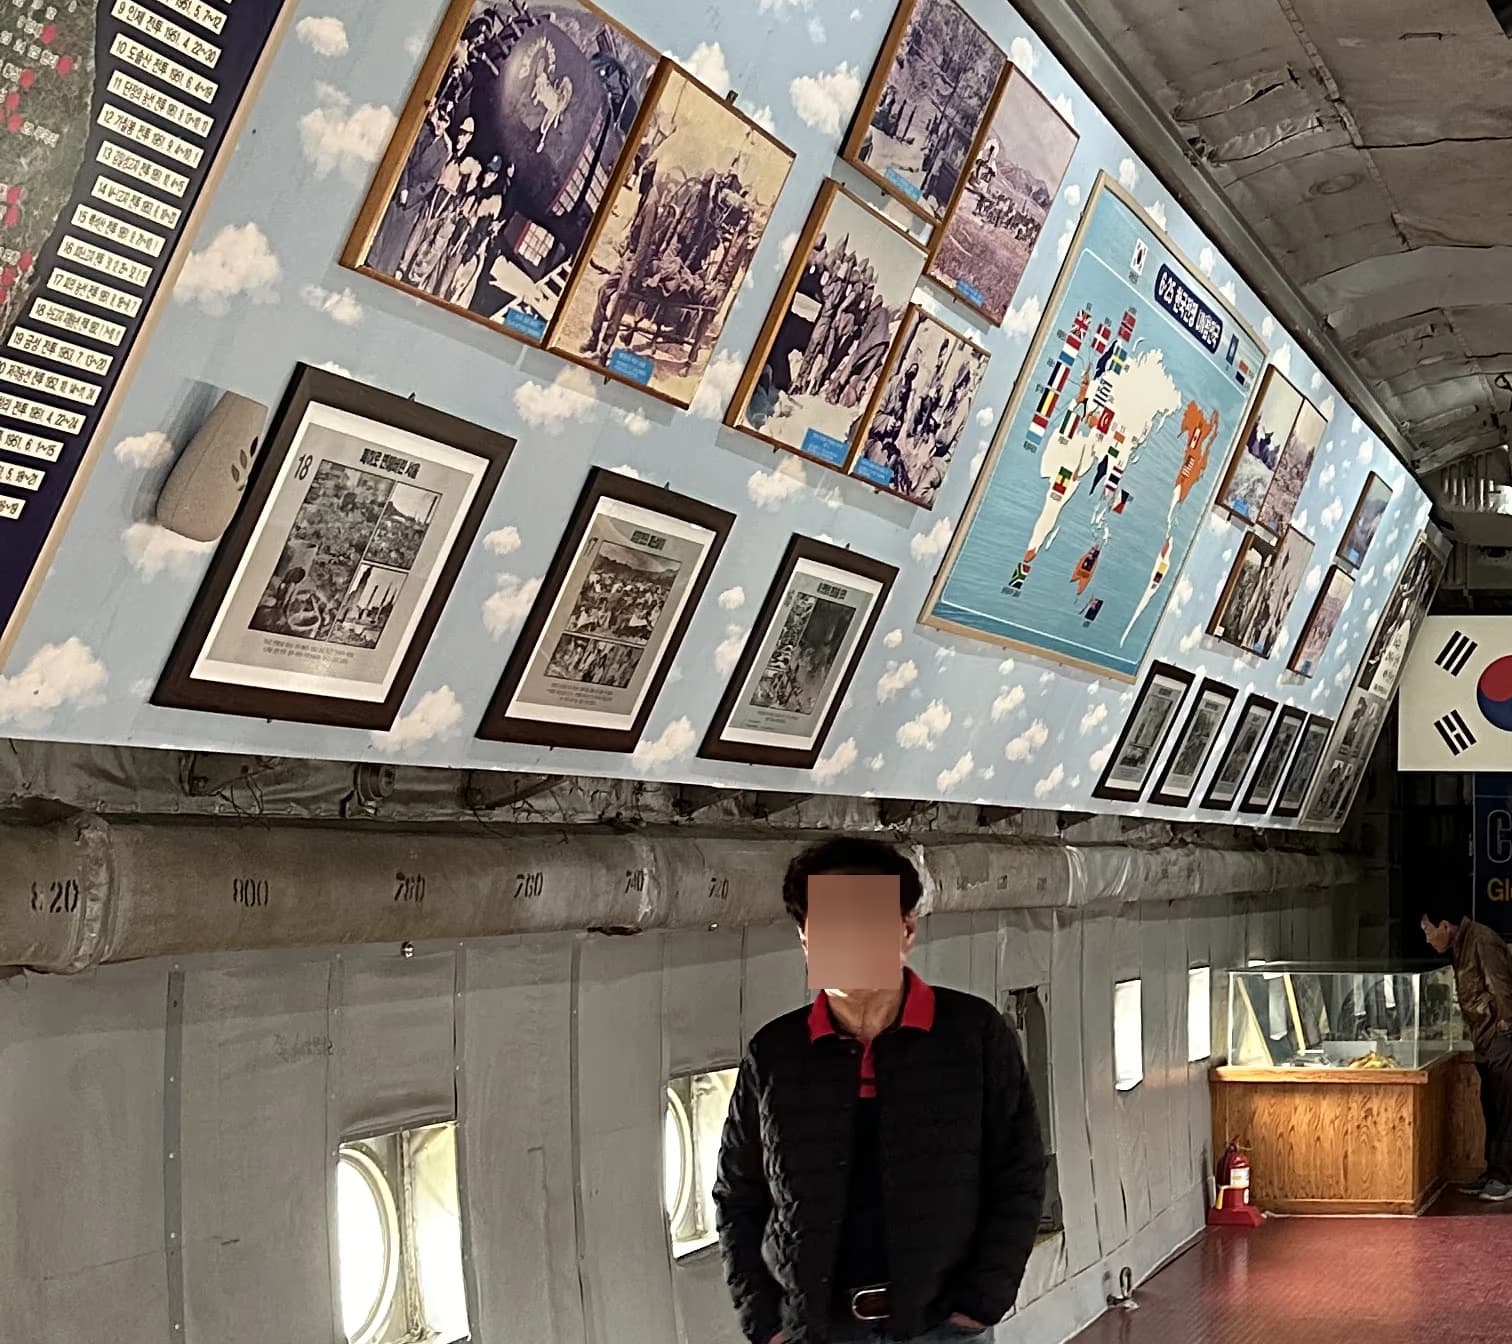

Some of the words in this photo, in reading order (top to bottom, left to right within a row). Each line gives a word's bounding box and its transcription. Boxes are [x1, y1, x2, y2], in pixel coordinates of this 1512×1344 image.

[116, 0, 127, 15] 9
[124, 2, 146, 26] 인제
[144, 13, 165, 36] 전투
[115, 38, 128, 56] 10
[126, 43, 154, 69] 도솔산
[150, 55, 170, 77] 전투
[111, 74, 123, 91] 11
[152, 94, 168, 114] 전투
[101, 108, 115, 125] 12
[134, 122, 152, 142] 전투
[100, 145, 113, 162] 13
[75, 208, 89, 224] 15
[51, 272, 64, 287] 17
[33, 302, 47, 317] 18
[1172, 286, 1199, 328] 한국전쟁
[12, 329, 26, 345] 19
[22, 331, 43, 351] 금성
[40, 337, 59, 356] 전투
[10, 400, 29, 418] 전투
[294, 454, 314, 481] 18
